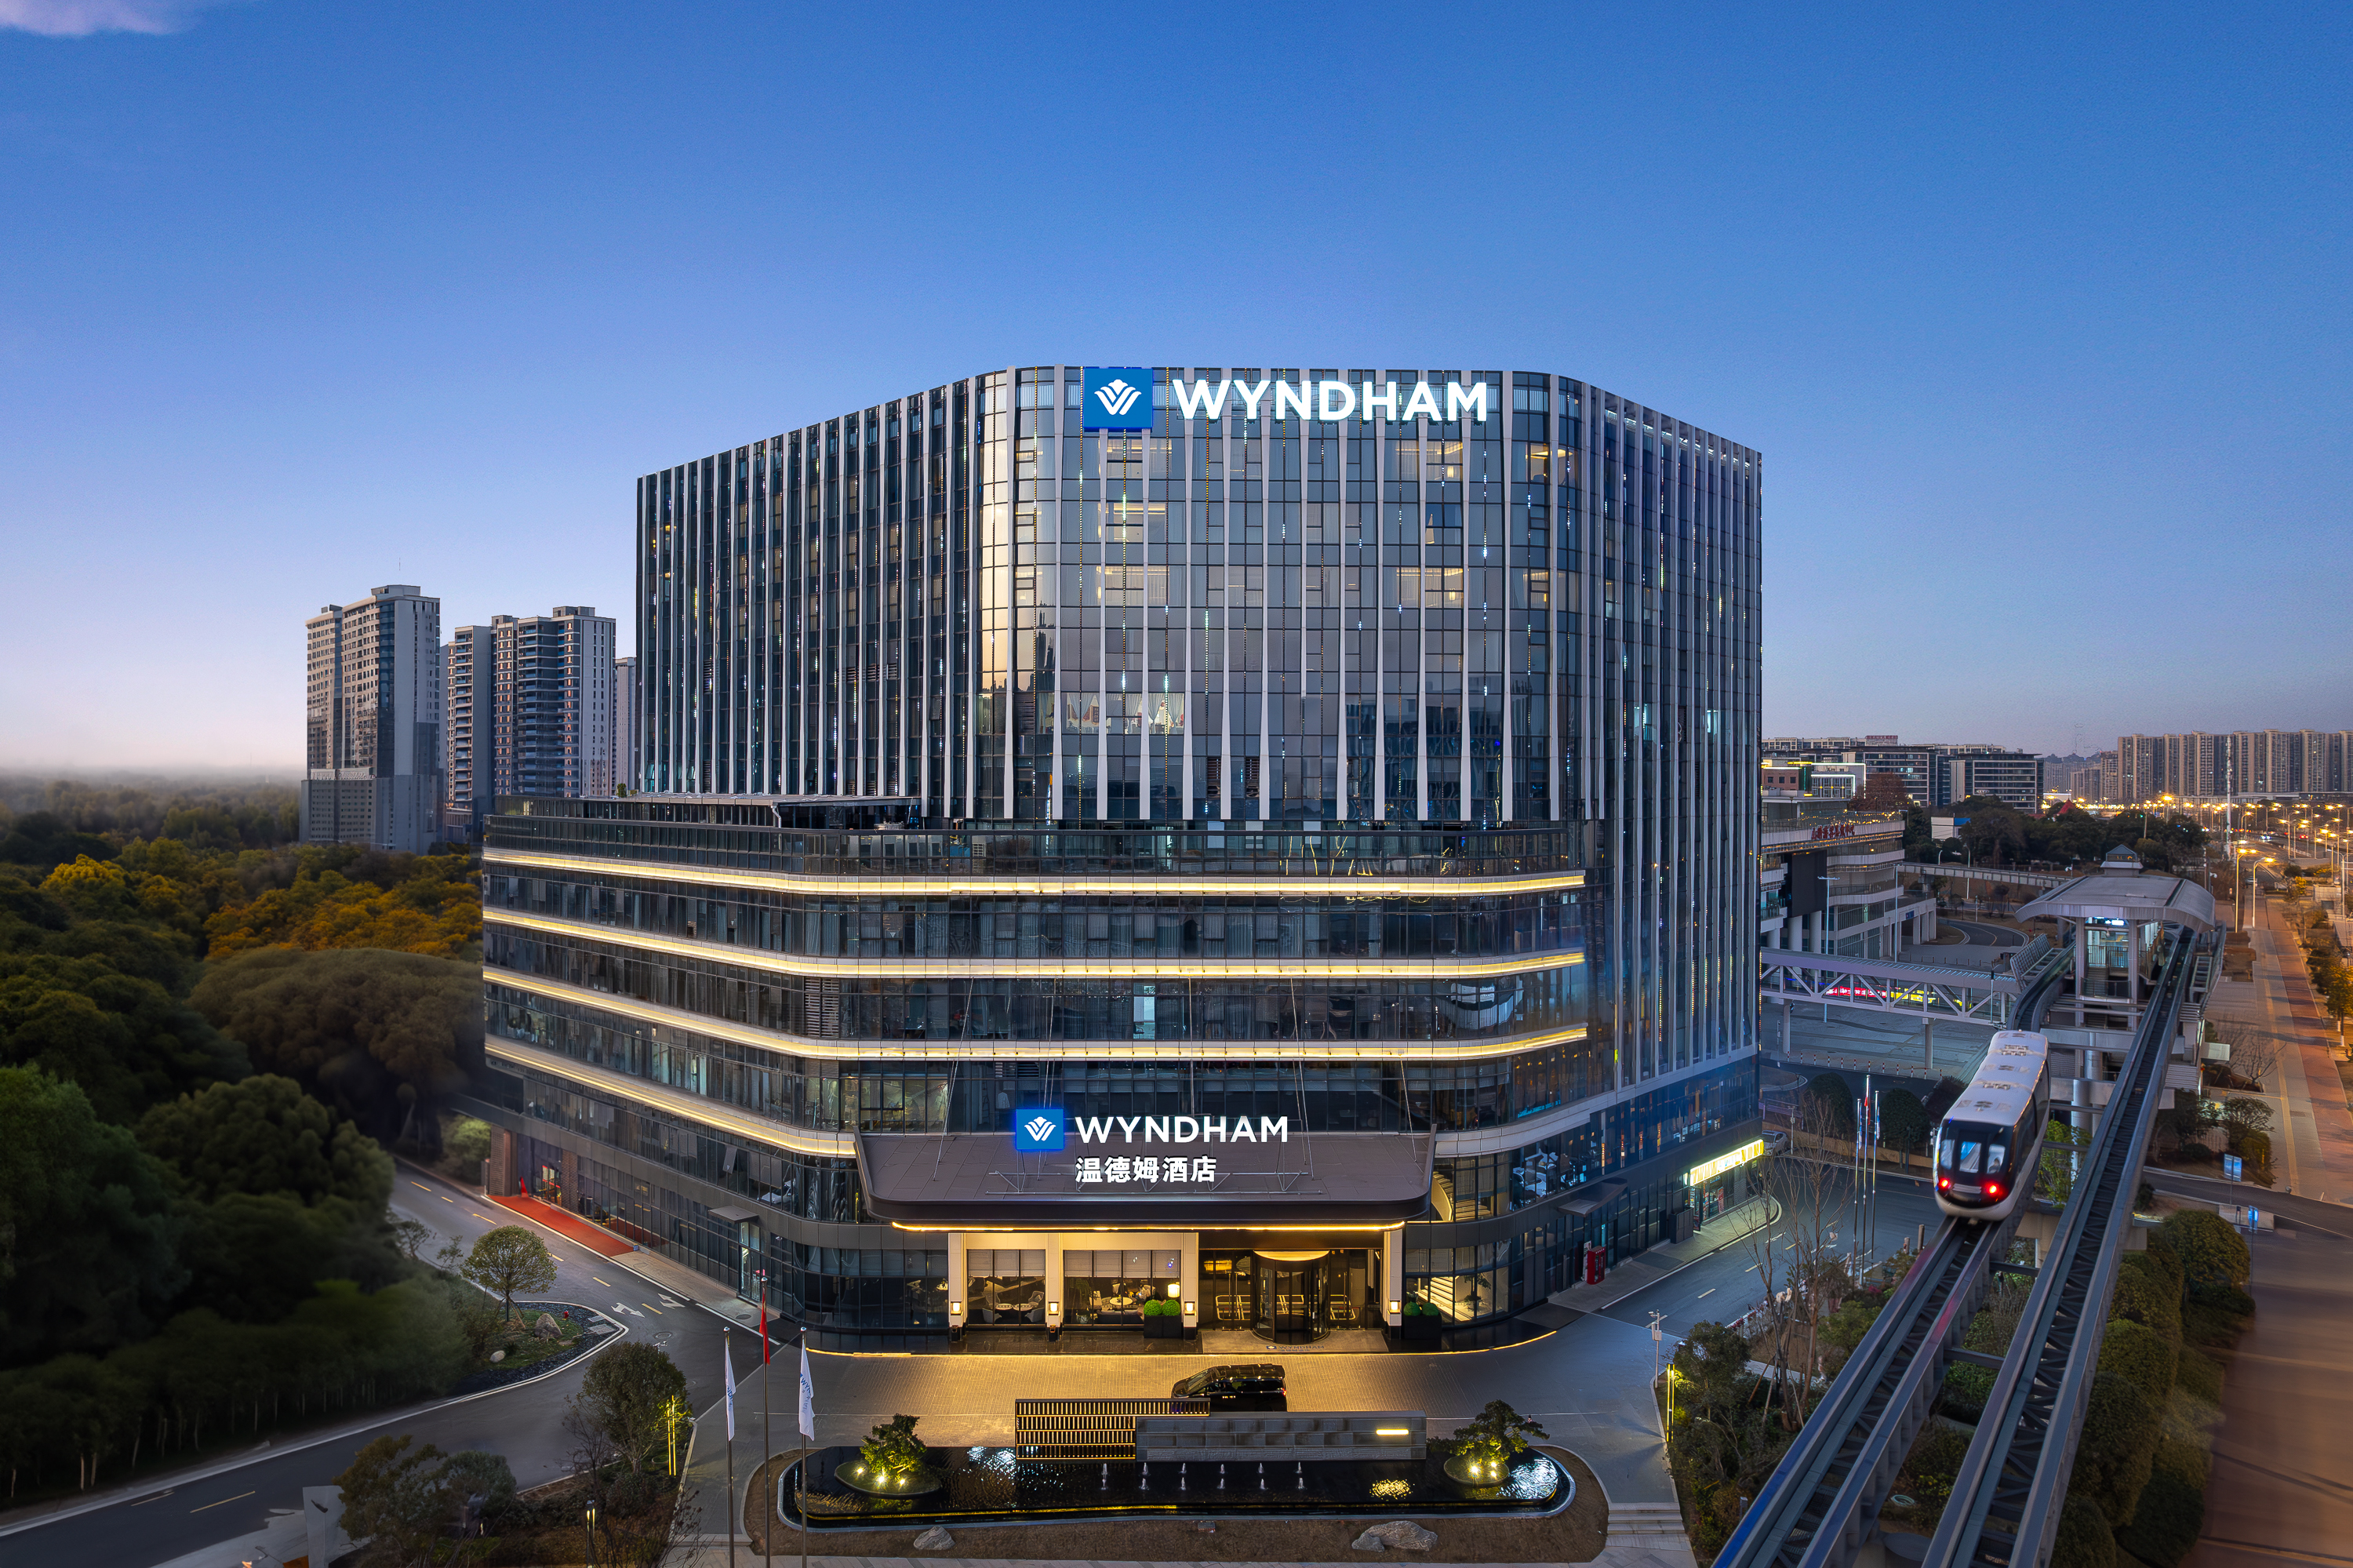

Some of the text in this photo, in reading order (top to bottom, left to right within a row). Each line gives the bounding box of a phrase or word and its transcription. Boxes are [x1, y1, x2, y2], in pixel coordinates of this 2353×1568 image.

[1173, 379, 1487, 421] WYNDHAM
[1075, 1116, 1289, 1143] WYNDHAM
[1075, 1156, 1217, 1183] 温德姆酒店
